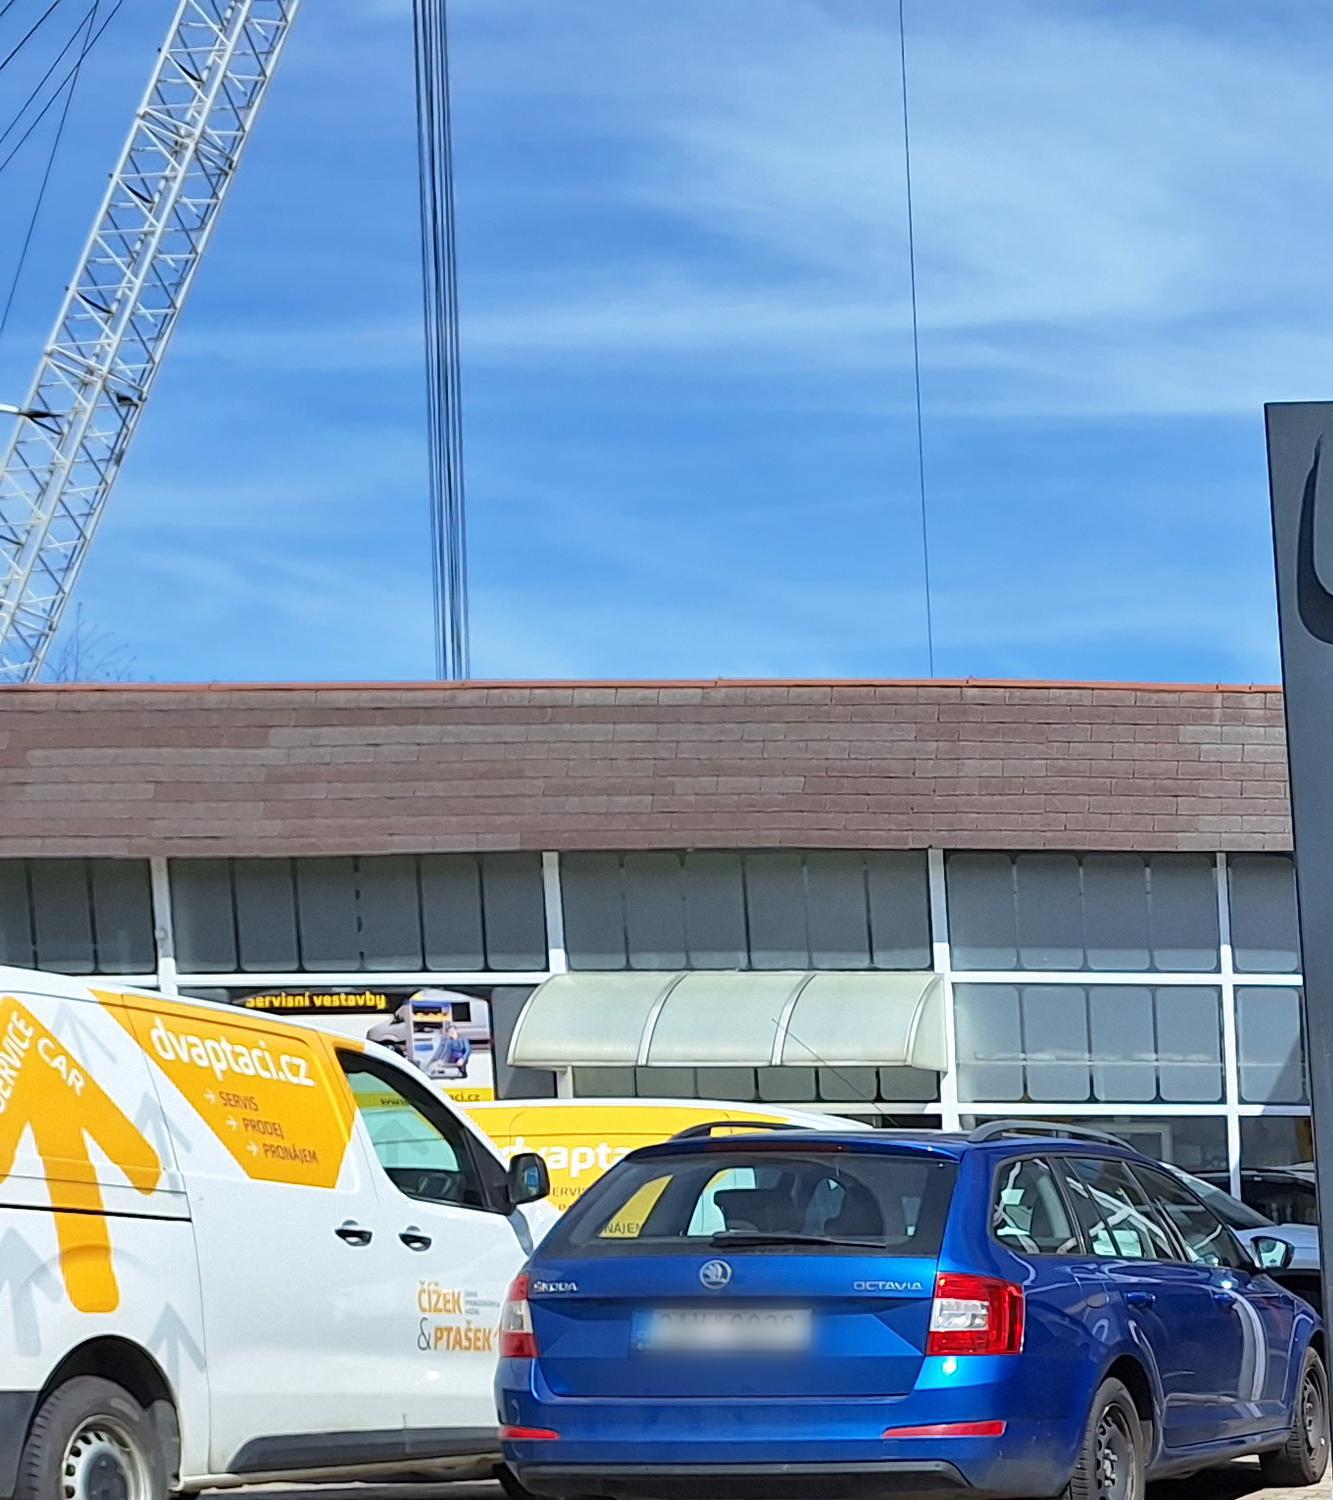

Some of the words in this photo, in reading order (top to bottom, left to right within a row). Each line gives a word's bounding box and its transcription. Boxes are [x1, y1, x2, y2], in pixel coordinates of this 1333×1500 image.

[313, 991, 387, 1010] vestavby
[149, 1016, 317, 1087] dvaptaci.cz
[37, 1037, 86, 1097] CAR
[219, 1091, 259, 1112] SERVIS
[242, 1117, 285, 1140] PRODEJ
[417, 1280, 465, 1314] ČÍŽEK
[533, 1280, 579, 1292] ŠKODA
[853, 1281, 923, 1291] OCTAVIA
[433, 1319, 492, 1352] PTAŠEK
